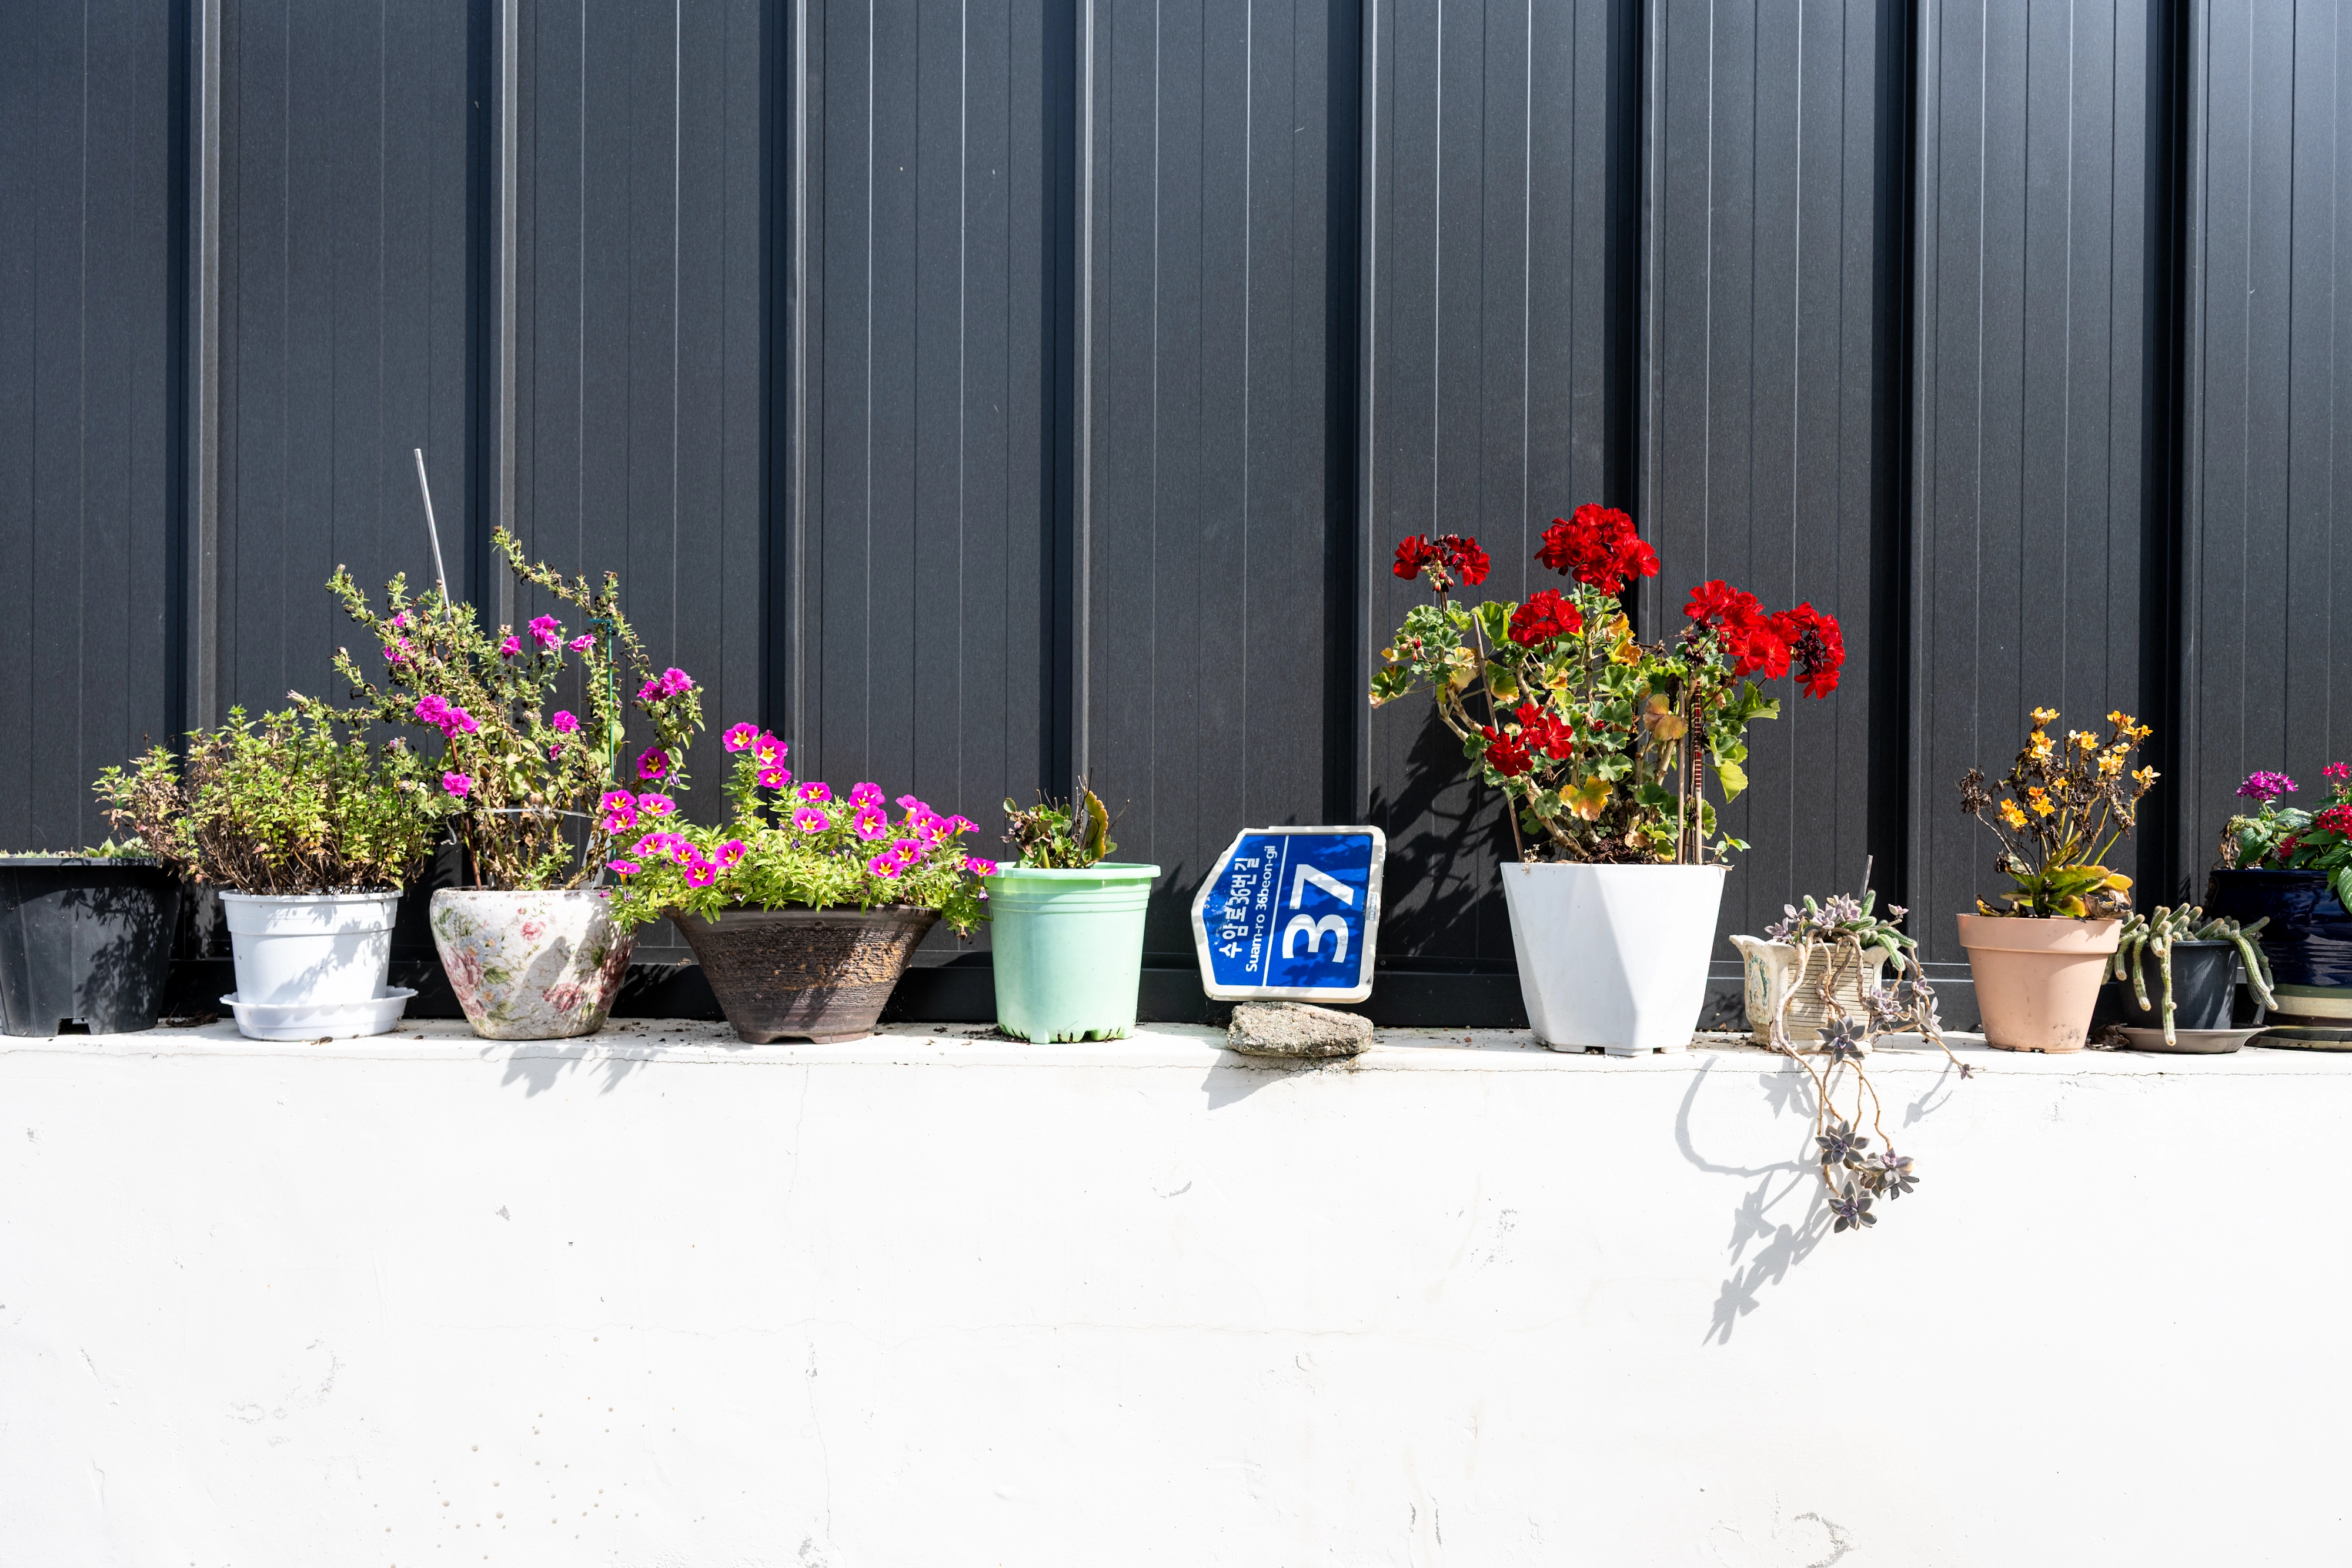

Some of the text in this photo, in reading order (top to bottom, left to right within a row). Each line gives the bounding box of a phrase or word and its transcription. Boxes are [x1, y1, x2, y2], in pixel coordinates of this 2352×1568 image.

[1219, 858, 1259, 958] 수암로36번길
[1245, 845, 1278, 972] Suam-ro 36beon-gil
[1282, 864, 1354, 964] 37
